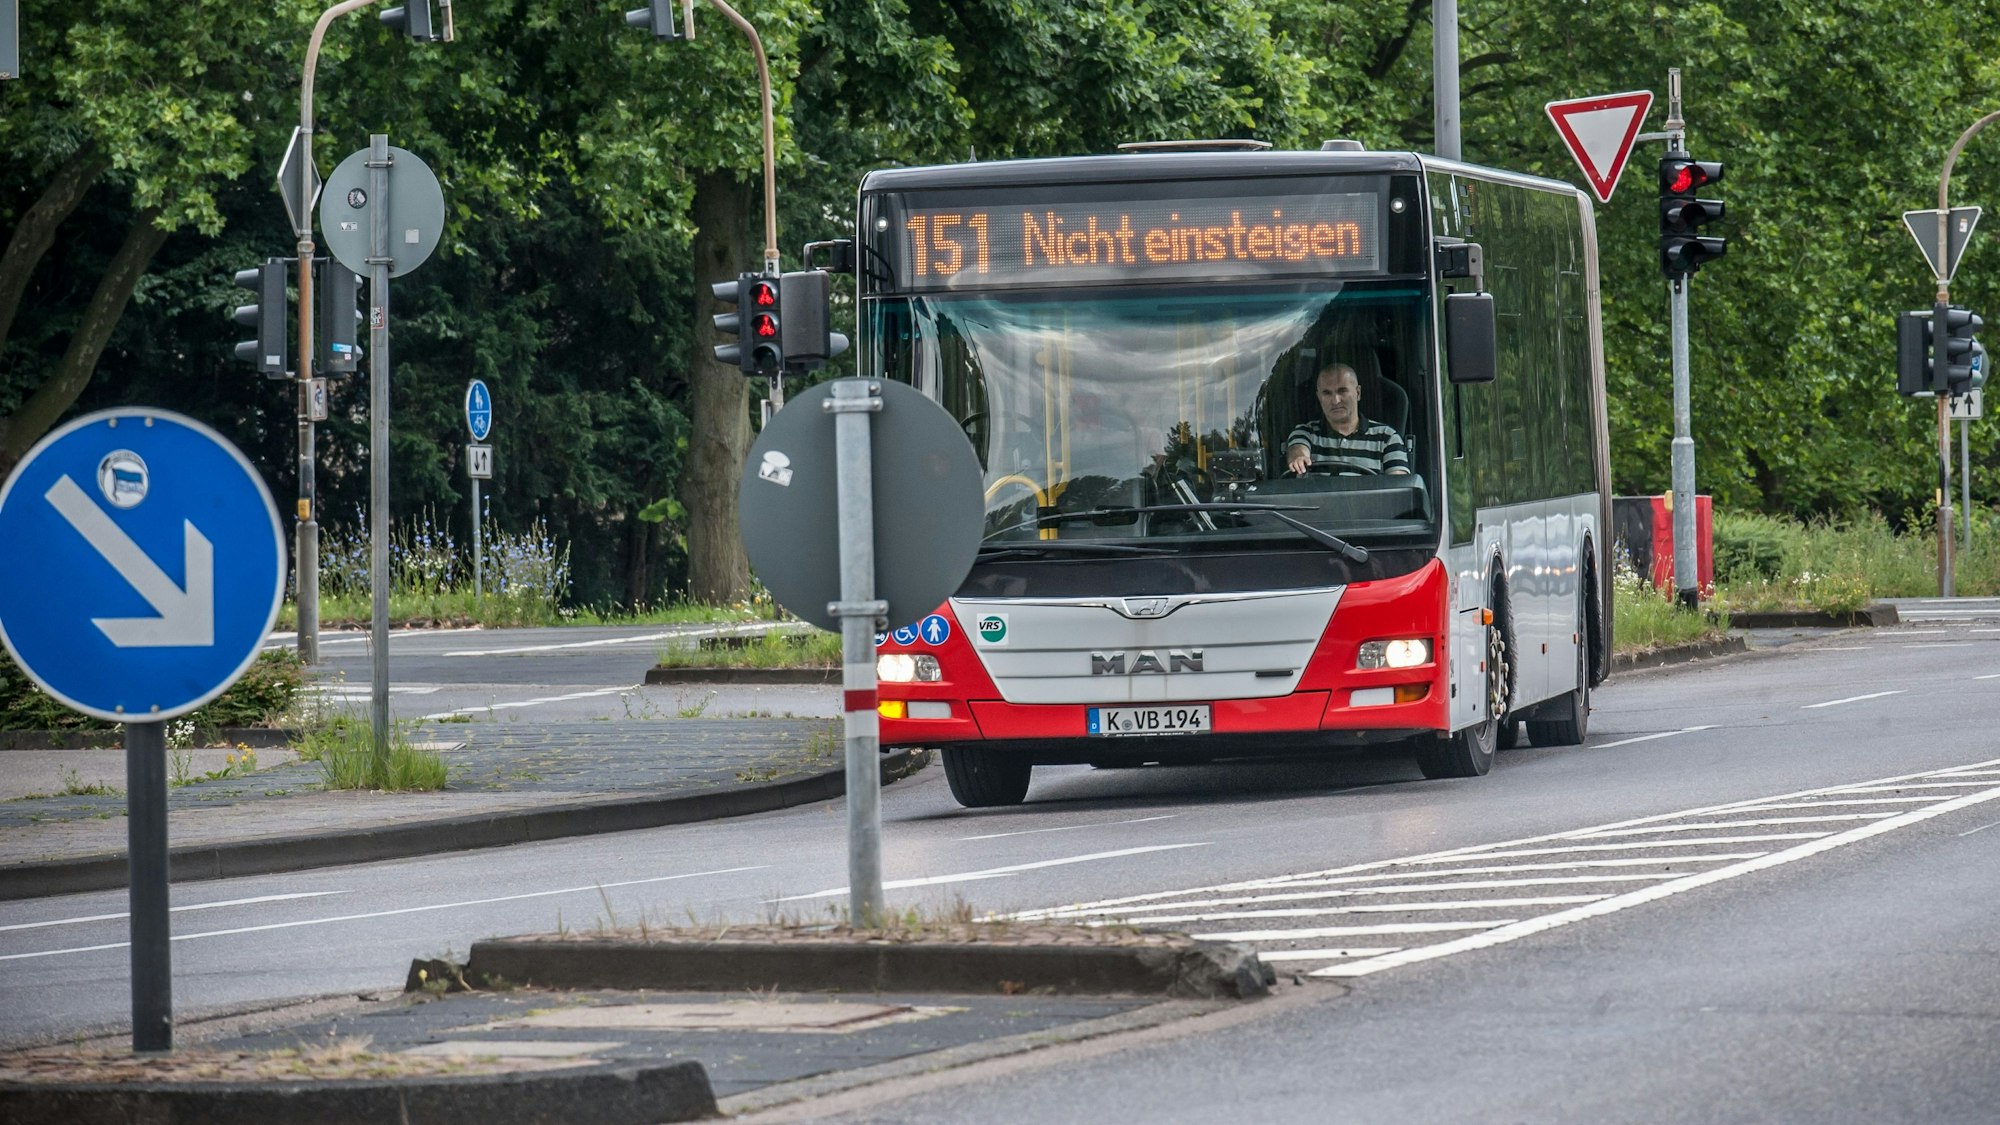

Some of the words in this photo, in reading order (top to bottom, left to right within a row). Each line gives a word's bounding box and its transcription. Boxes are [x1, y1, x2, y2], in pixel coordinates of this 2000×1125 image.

[906, 213, 988, 276] 151
[1023, 211, 1136, 266] Nicht
[1145, 209, 1360, 260] einsteigen
[979, 621, 1000, 630] VRS
[1091, 650, 1204, 675] MAN
[1091, 722, 1097, 730] D
[1107, 711, 1120, 731] K
